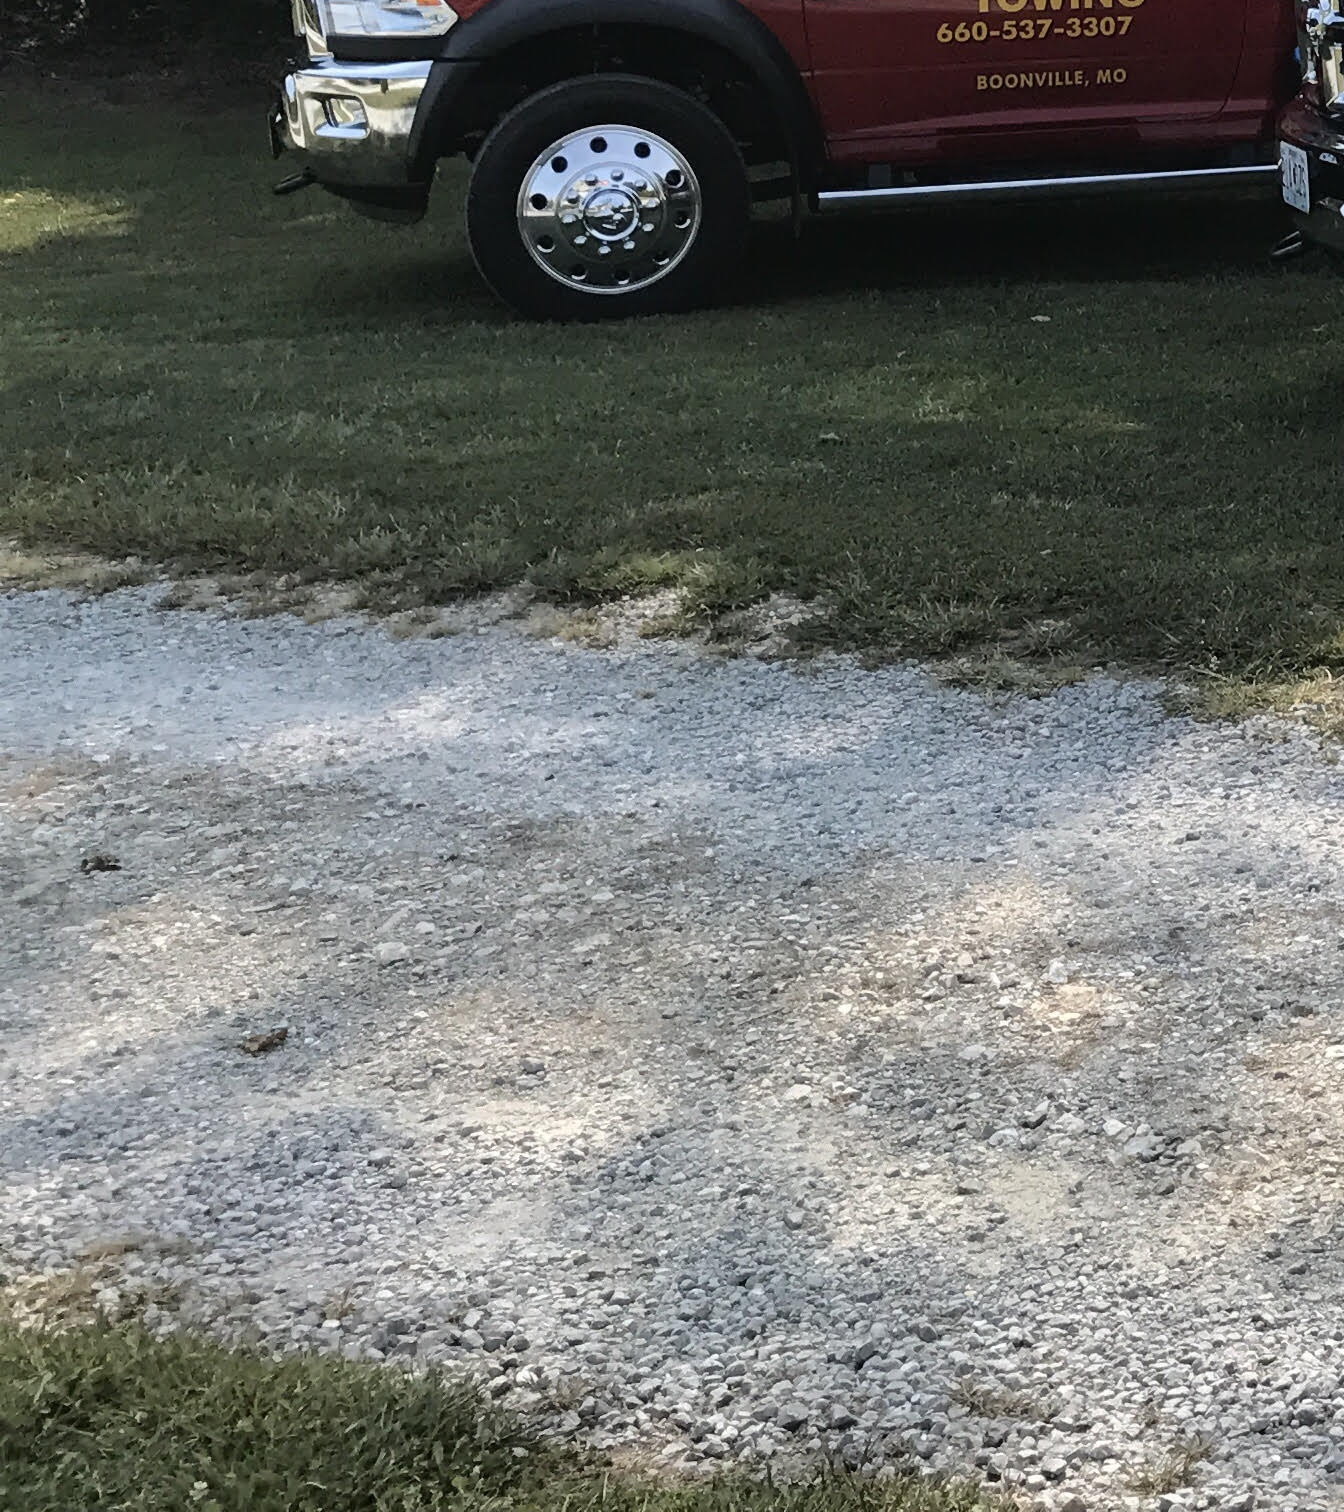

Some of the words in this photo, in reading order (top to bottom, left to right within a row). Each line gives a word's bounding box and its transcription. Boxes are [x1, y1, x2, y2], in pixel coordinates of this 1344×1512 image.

[936, 15, 1133, 43] 660-537-3307
[976, 71, 1090, 90] BOONVILLE,
[1097, 68, 1127, 84] MO
